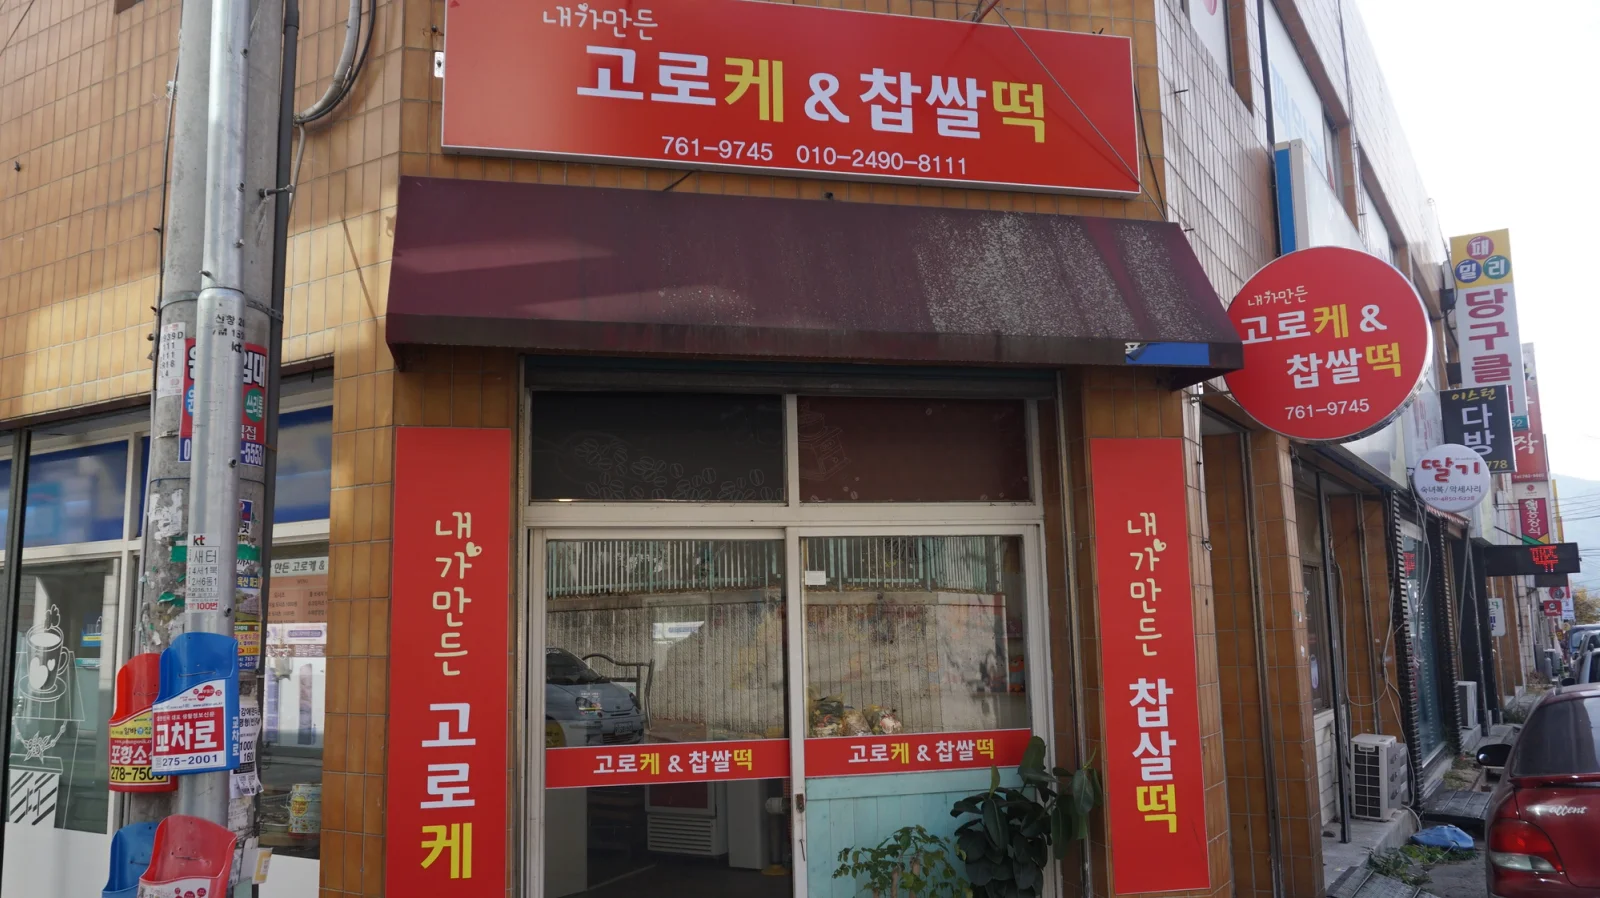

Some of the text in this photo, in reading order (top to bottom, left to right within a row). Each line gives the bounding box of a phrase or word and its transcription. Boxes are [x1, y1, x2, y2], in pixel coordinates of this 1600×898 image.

[543, 3, 658, 40] 내가만든
[577, 45, 1045, 143] 고로케 & 찹쌀떡
[661, 136, 967, 175] 761-9745 010-2490-8111
[1247, 285, 1309, 307] 내가만든
[1241, 303, 1387, 345] 고로케 &
[1286, 343, 1402, 389] 찹쌀떡
[1466, 288, 1515, 414] 당구클
[1285, 398, 1370, 420] 761-9745
[1421, 457, 1481, 483] 딸기
[193, 535, 205, 546] kt
[432, 511, 483, 677] 내가만든
[1127, 511, 1167, 657] 내가만든
[111, 745, 153, 764] 포항소
[155, 720, 218, 752] 교차로
[848, 739, 994, 764] 고로케 & 찹쌀떡
[162, 754, 218, 767] 275-2001
[593, 749, 753, 775] 고로케 & 찹쌀떡
[1129, 678, 1177, 833] 찹살떡
[420, 702, 476, 879] 고로케
